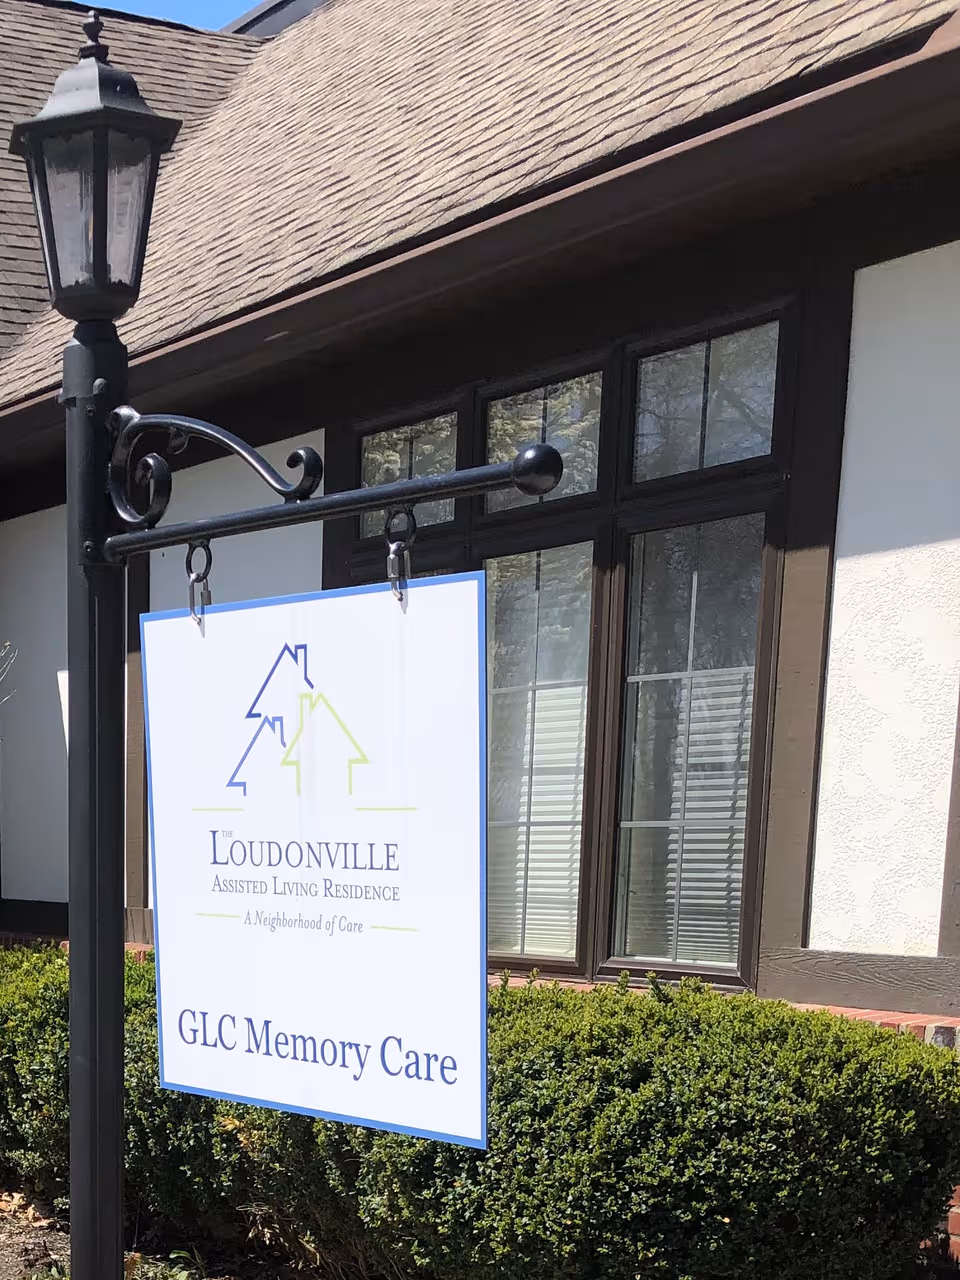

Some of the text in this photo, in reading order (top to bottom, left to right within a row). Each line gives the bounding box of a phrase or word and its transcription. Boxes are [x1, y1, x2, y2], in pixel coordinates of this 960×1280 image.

[208, 829, 400, 872] LOUDONVILLE
[211, 873, 400, 902] ASSISTED LIVING RESIDENCE
[244, 909, 364, 937] A Neighborhood of Care
[177, 1008, 458, 1086] GLC Memory Care
